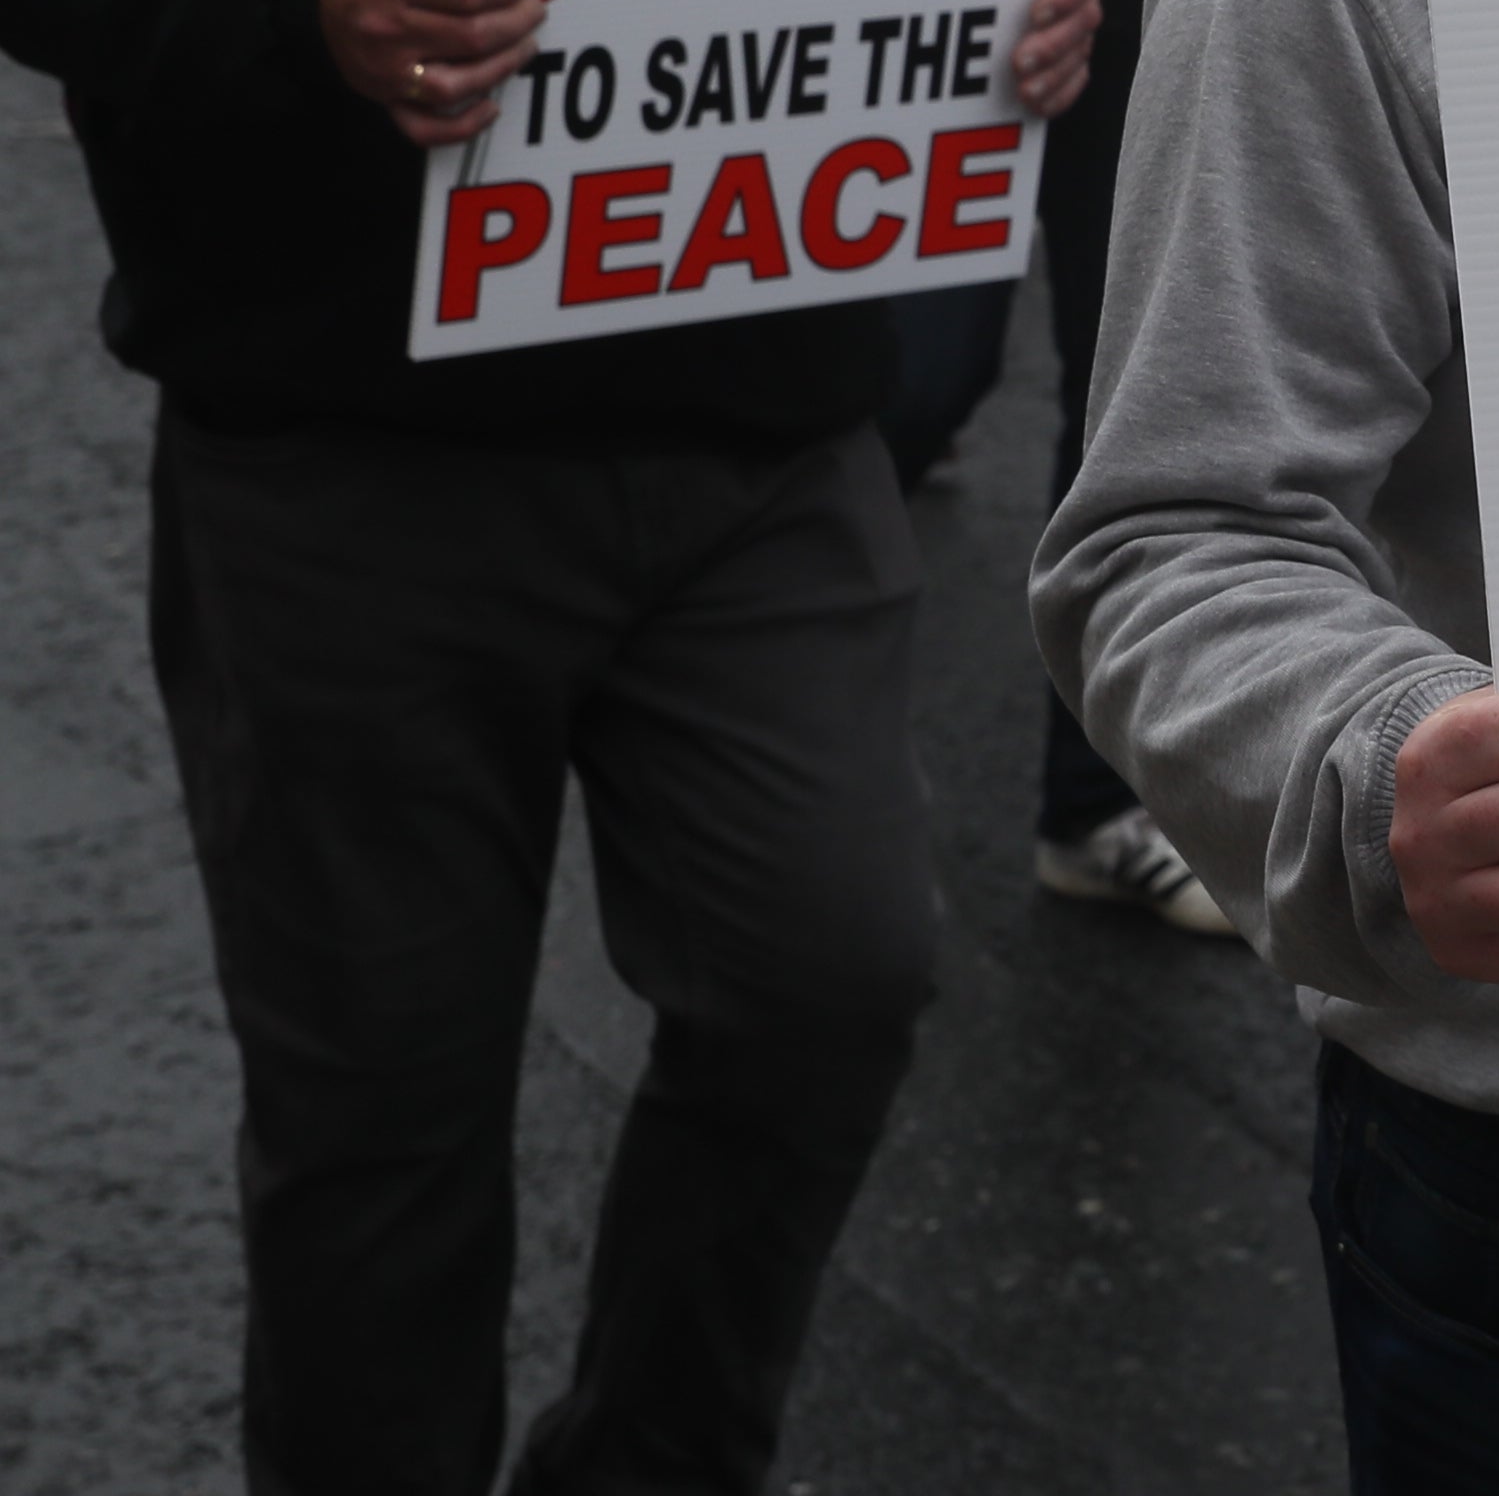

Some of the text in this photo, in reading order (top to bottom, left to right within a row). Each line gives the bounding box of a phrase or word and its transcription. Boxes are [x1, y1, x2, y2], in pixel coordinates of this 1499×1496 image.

[517, 7, 998, 146] TO SAVE THE
[436, 121, 1024, 327] PEACE
